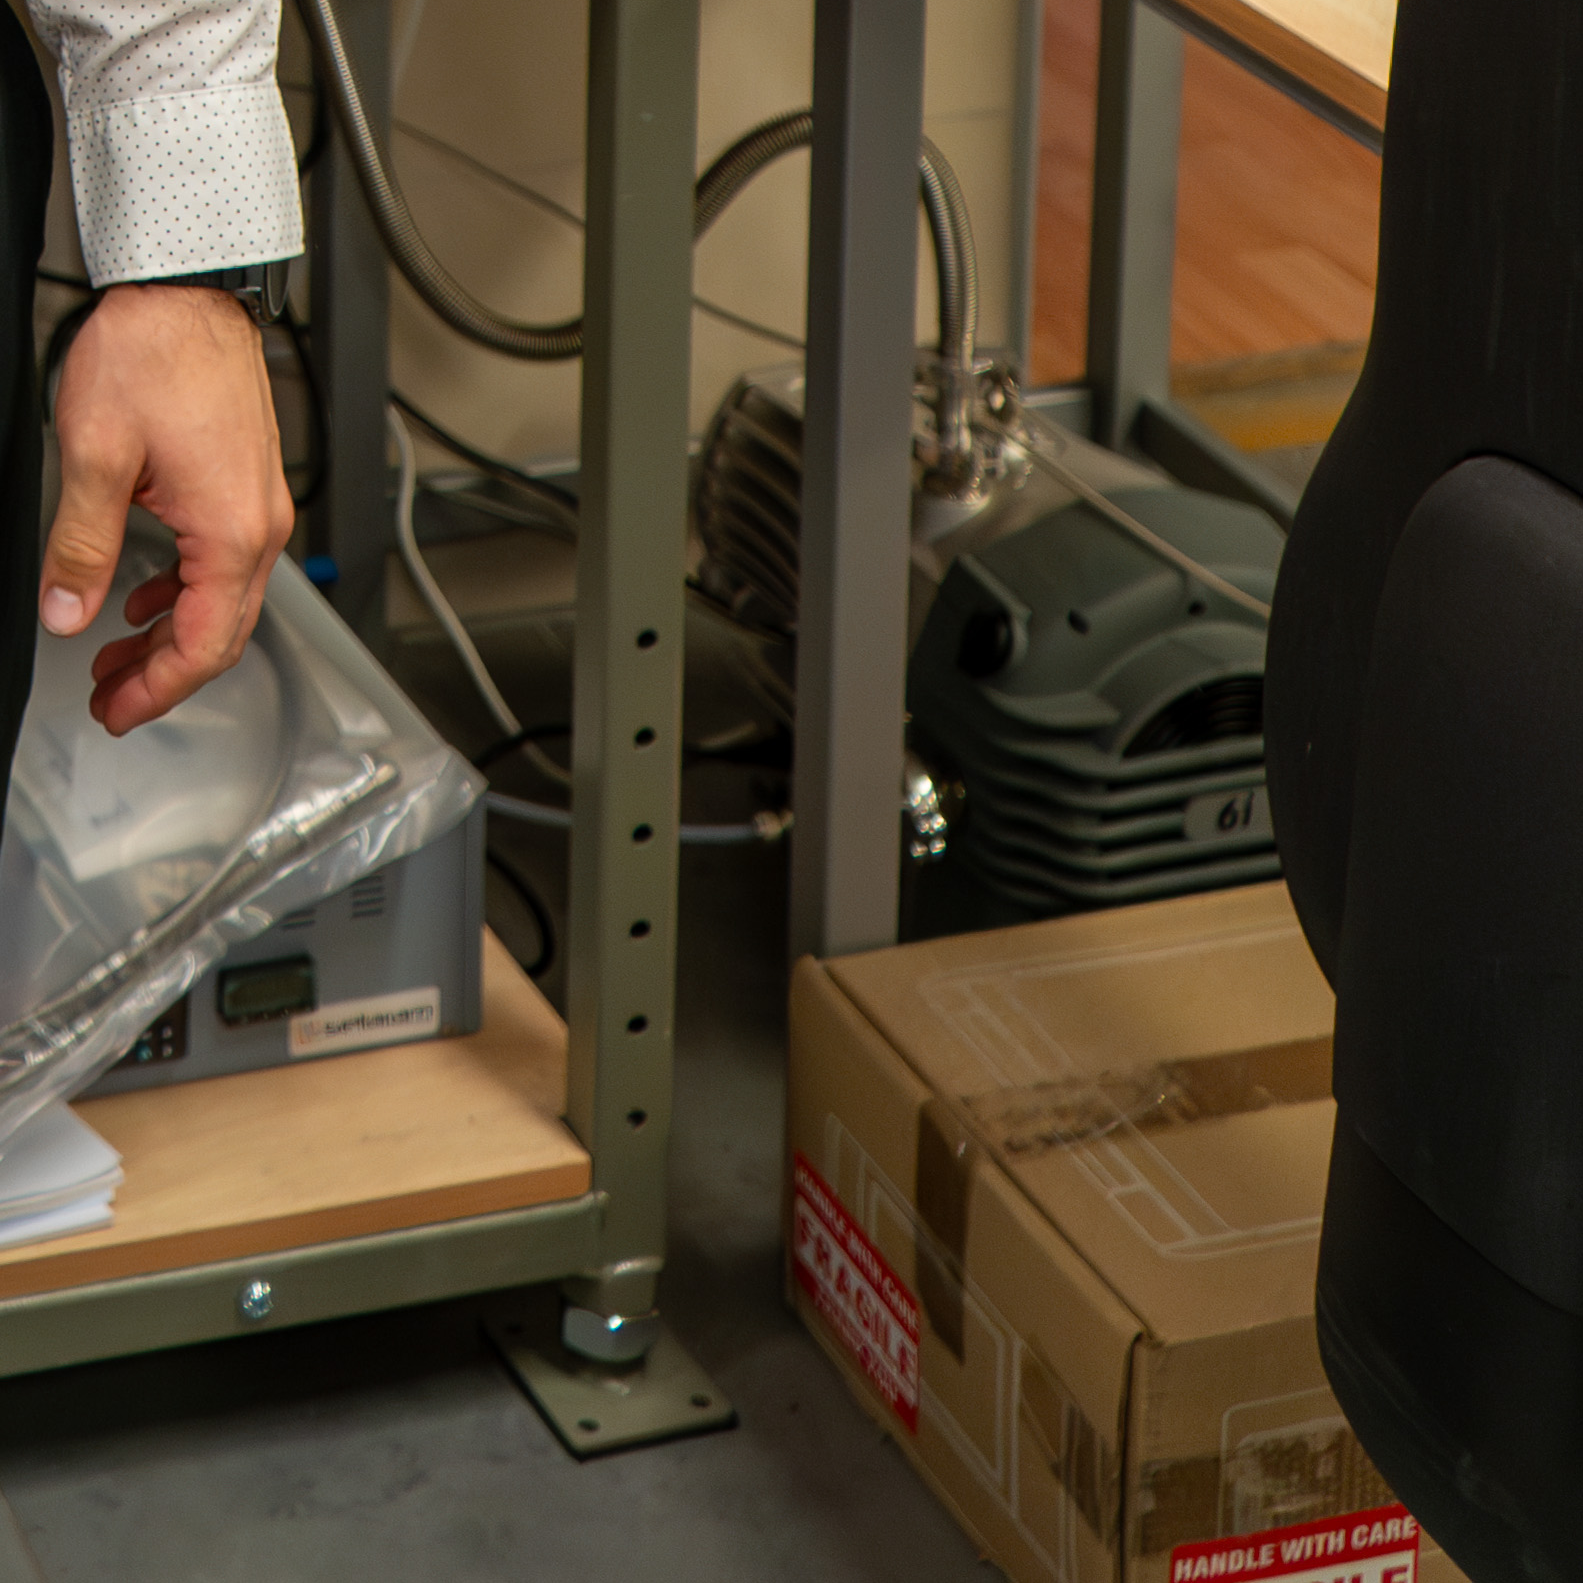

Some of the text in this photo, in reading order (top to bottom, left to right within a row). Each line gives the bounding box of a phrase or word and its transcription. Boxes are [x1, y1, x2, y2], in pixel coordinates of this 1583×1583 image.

[1174, 1542, 1276, 1583] HANDLE
[1281, 1528, 1347, 1564] WITH
[1350, 1514, 1419, 1552] CARE
